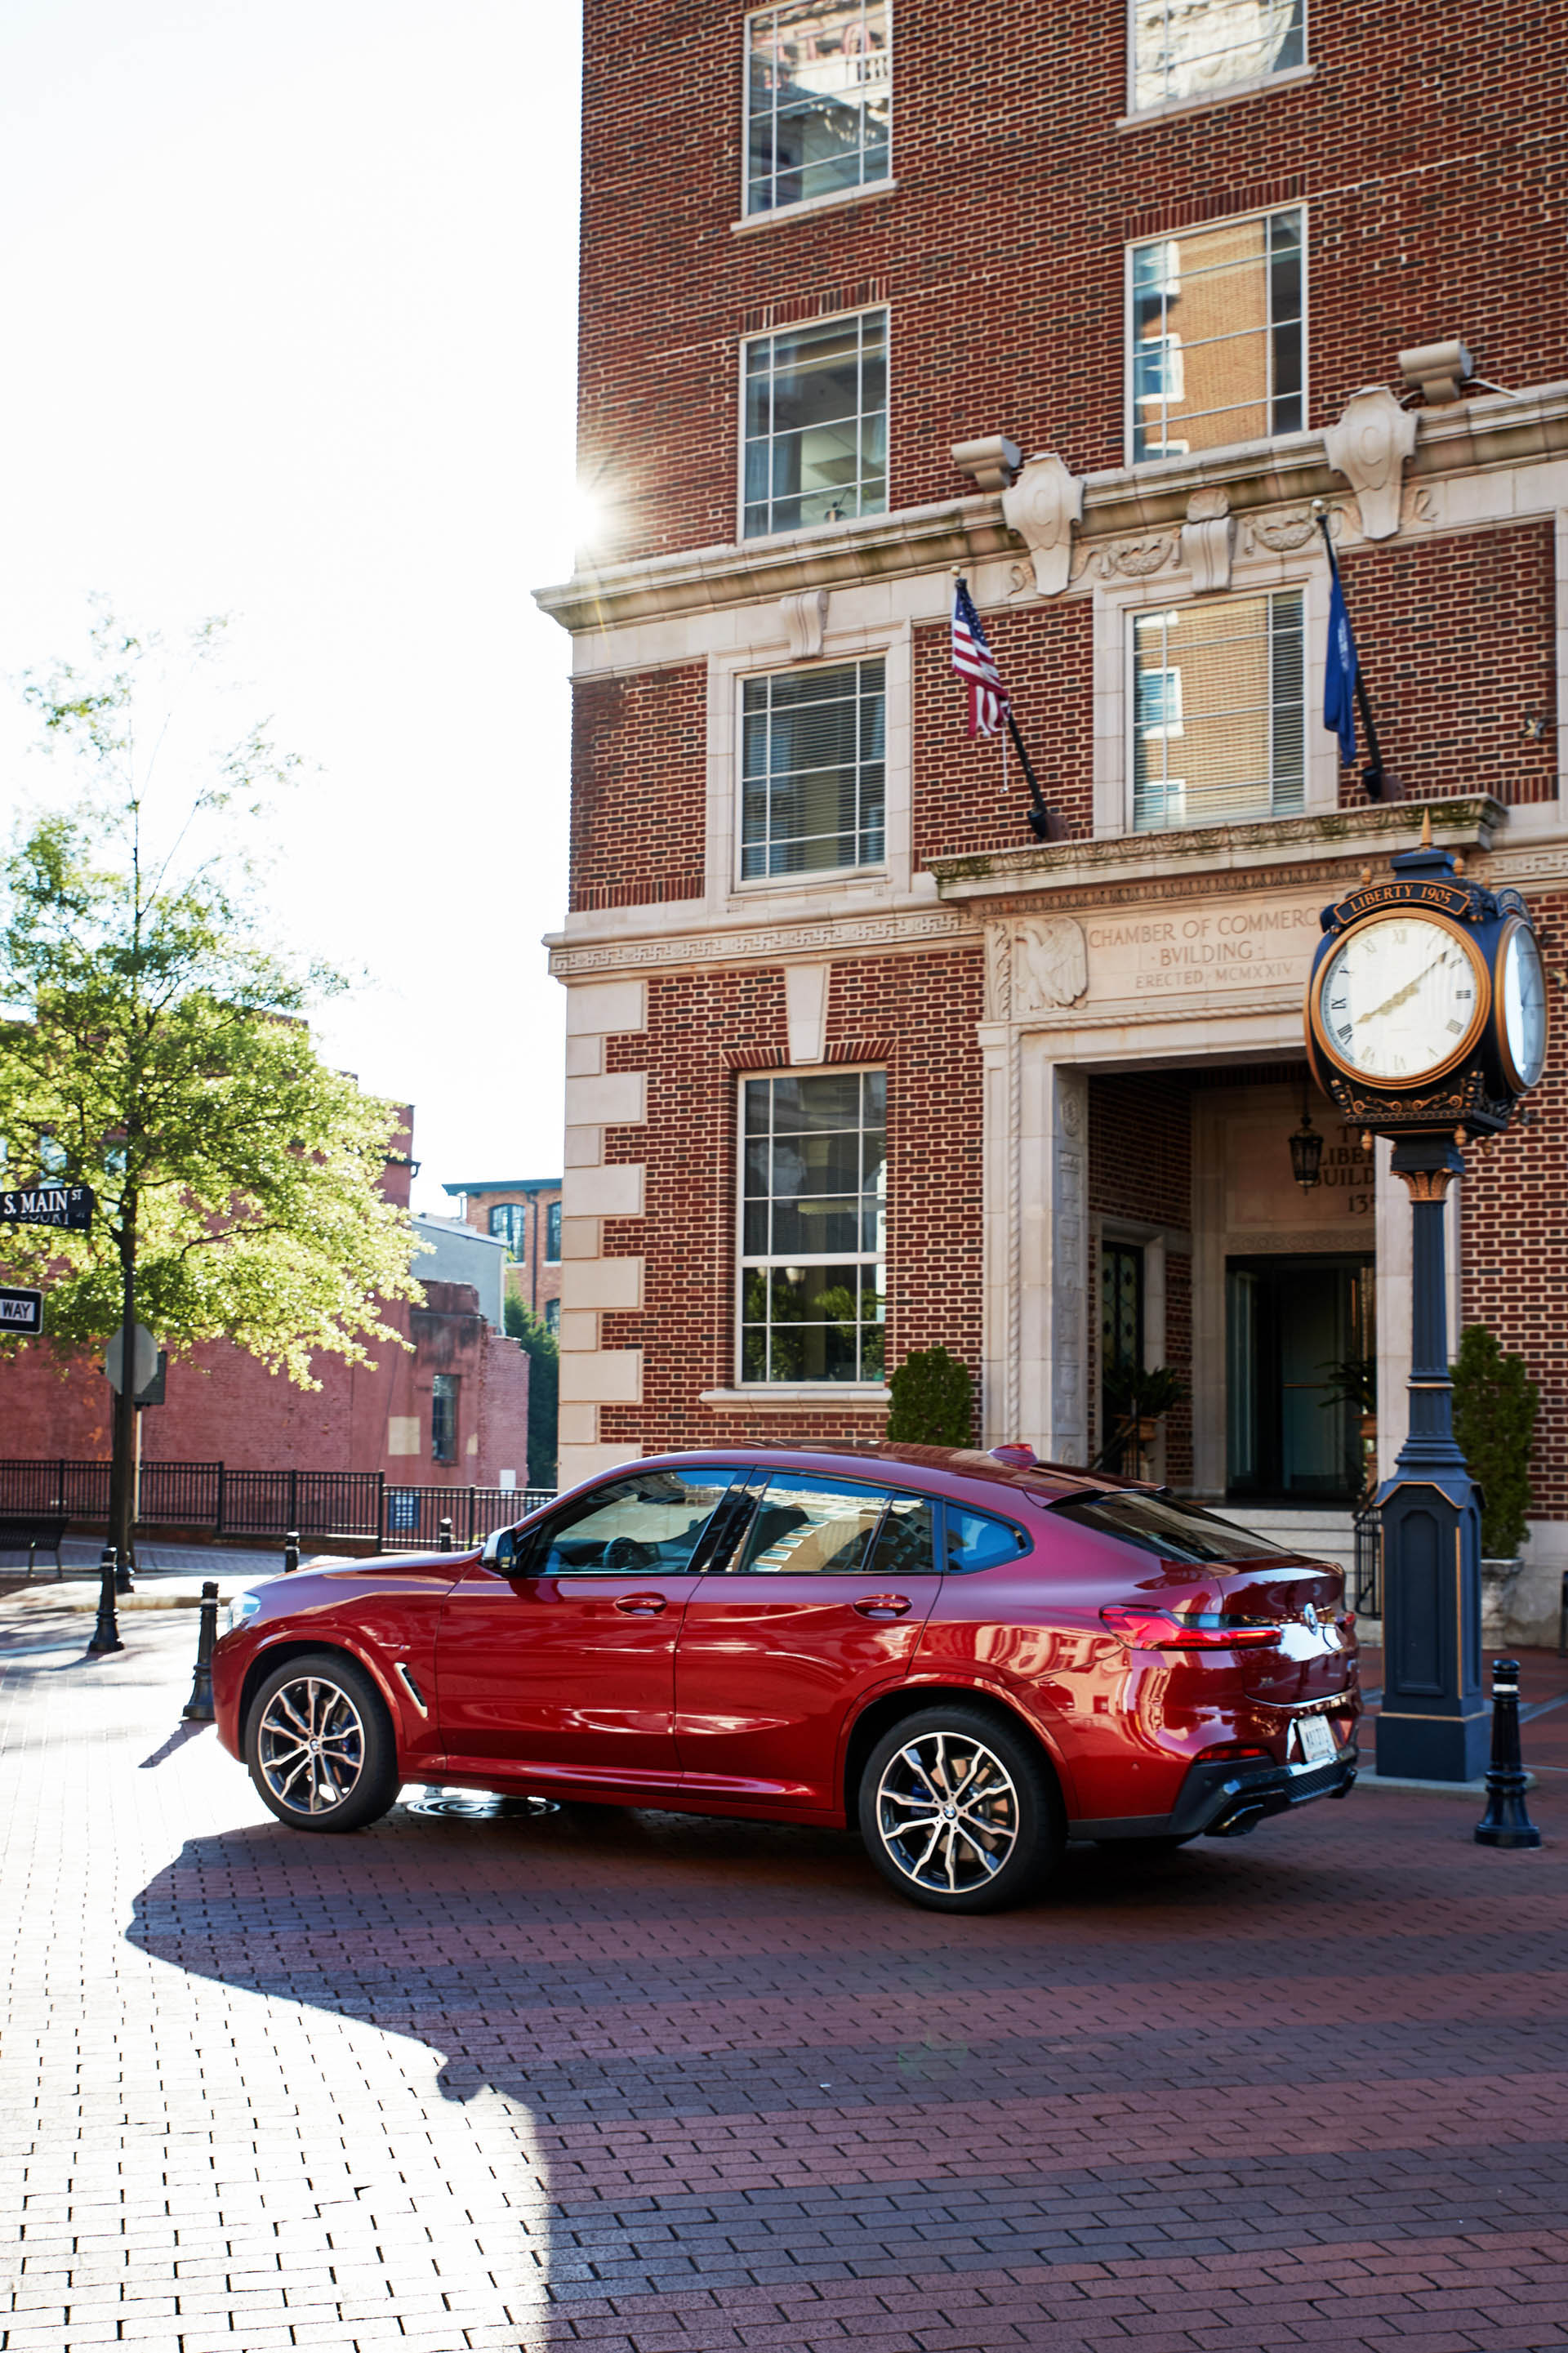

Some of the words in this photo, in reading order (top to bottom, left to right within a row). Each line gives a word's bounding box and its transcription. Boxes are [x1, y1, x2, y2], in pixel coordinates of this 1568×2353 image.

[1350, 885, 1414, 912] LIBERTY
[1420, 886, 1454, 906] 1905
[1089, 923, 1177, 948] CHAMBER
[1182, 918, 1213, 939] OF
[1218, 907, 1324, 937] COMMERC
[1136, 969, 1203, 989] ERECTED
[1214, 962, 1294, 983] MCMXXIV
[3, 1193, 16, 1215] S.
[20, 1190, 69, 1214] MAIN
[71, 1189, 83, 1201] ST
[2, 1301, 31, 1319] WAY
